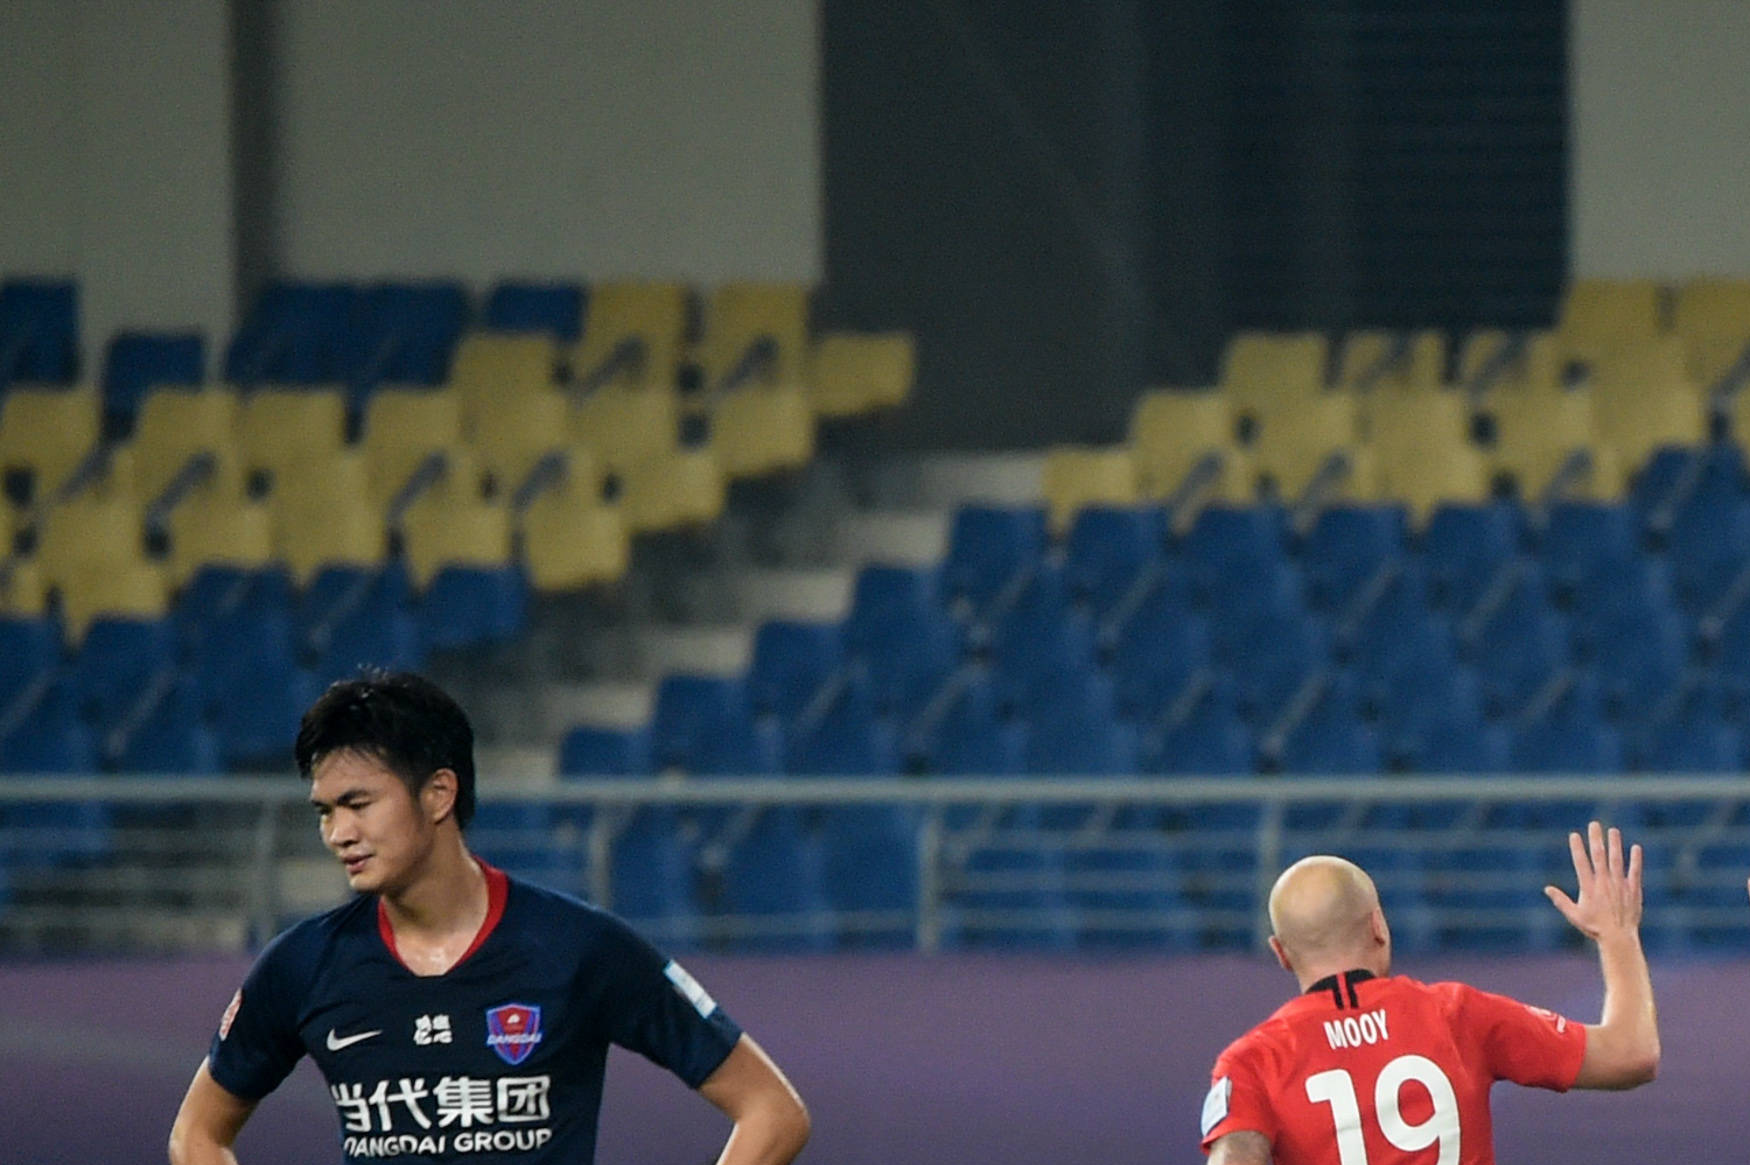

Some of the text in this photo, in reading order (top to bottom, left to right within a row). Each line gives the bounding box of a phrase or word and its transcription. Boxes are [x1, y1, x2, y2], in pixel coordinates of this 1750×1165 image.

[1323, 1008, 1389, 1049] MOOY
[331, 1074, 551, 1133] 当代集团
[453, 1127, 553, 1154] GROUP
